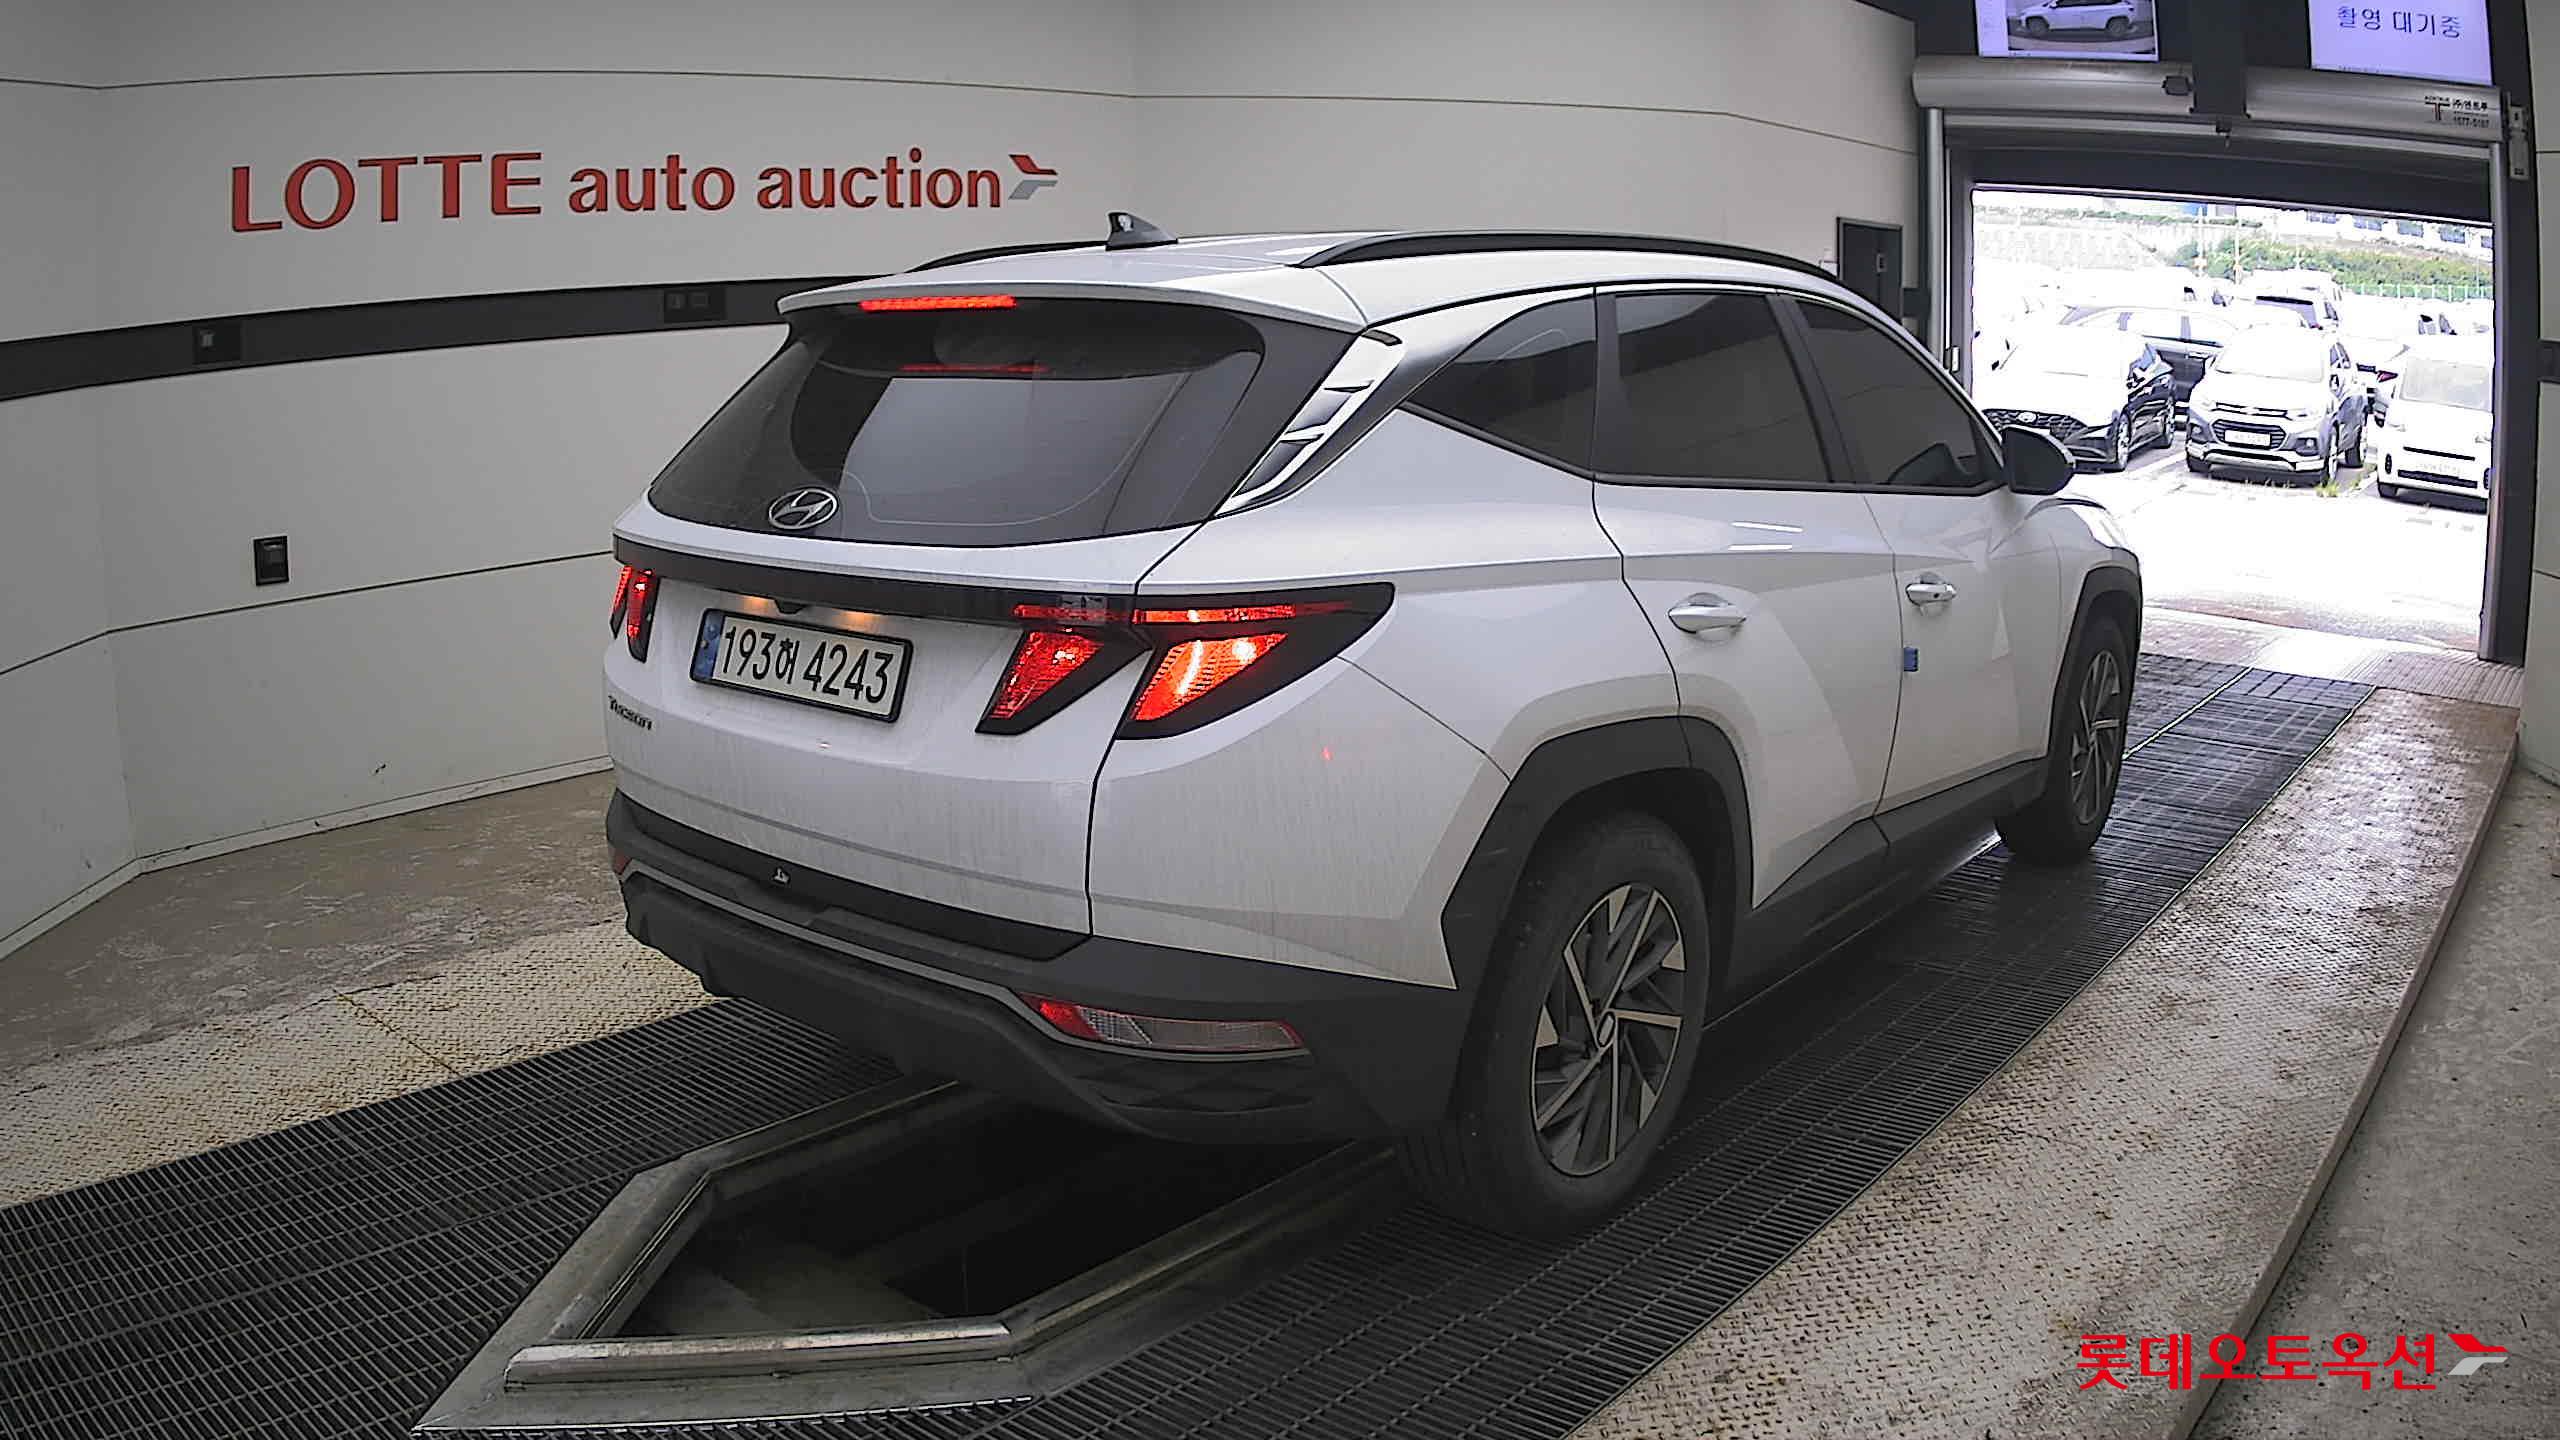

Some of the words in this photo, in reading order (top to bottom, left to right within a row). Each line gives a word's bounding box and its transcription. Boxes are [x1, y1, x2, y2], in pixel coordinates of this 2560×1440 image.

[2338, 5, 2382, 31] 촬영
[2392, 11, 2461, 39] 대기중
[231, 151, 543, 232] LOTTE
[567, 153, 736, 214] auto
[756, 147, 1001, 210] auction
[722, 625, 800, 685] 193허
[802, 641, 895, 704] 4243
